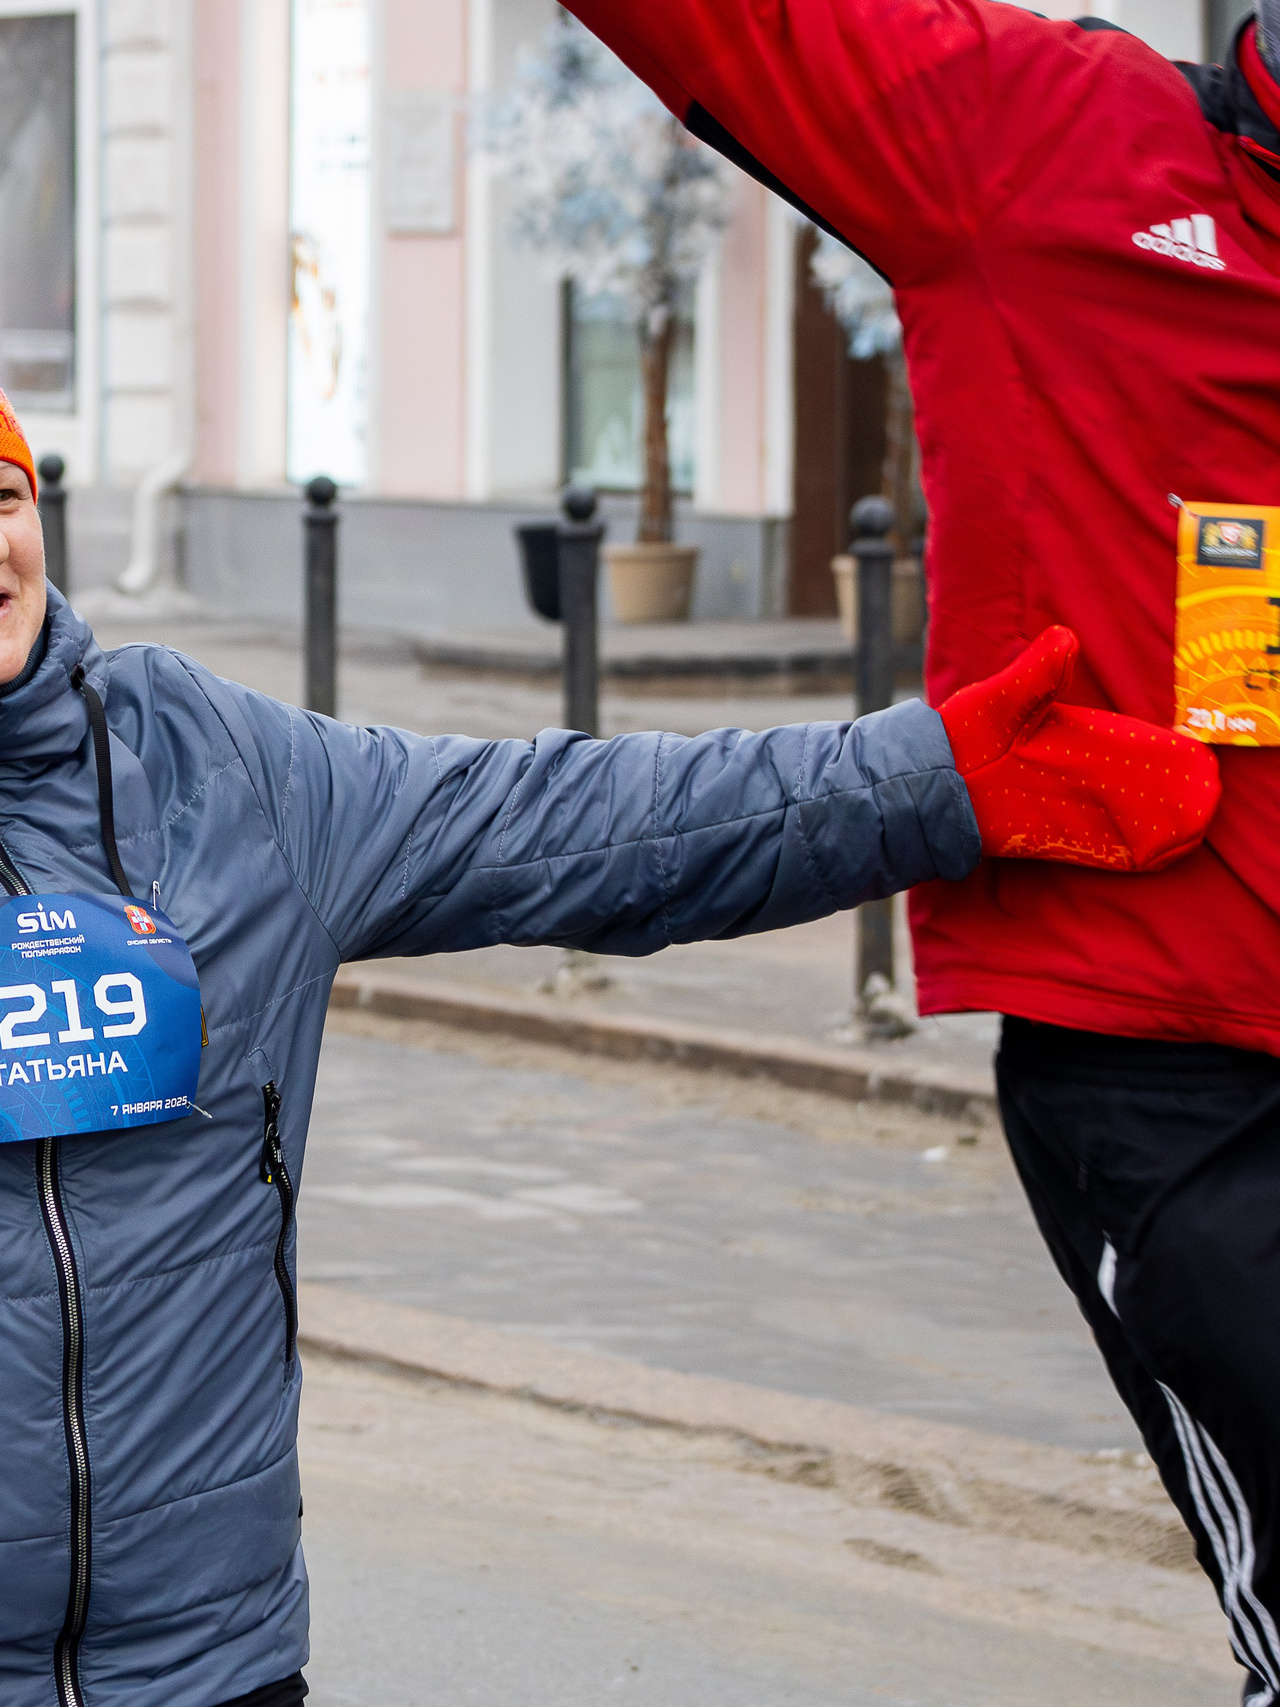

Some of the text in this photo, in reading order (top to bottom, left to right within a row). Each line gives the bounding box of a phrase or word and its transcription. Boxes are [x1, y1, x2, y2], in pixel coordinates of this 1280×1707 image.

[1131, 231, 1227, 271] adidas
[11, 934, 85, 950] РОЖДЕСТВЕНСКИЙ
[21, 945, 82, 959] ПОЛУМАРАФОН
[110, 1095, 188, 1116] 7 ЯНВАРЯ 2025
